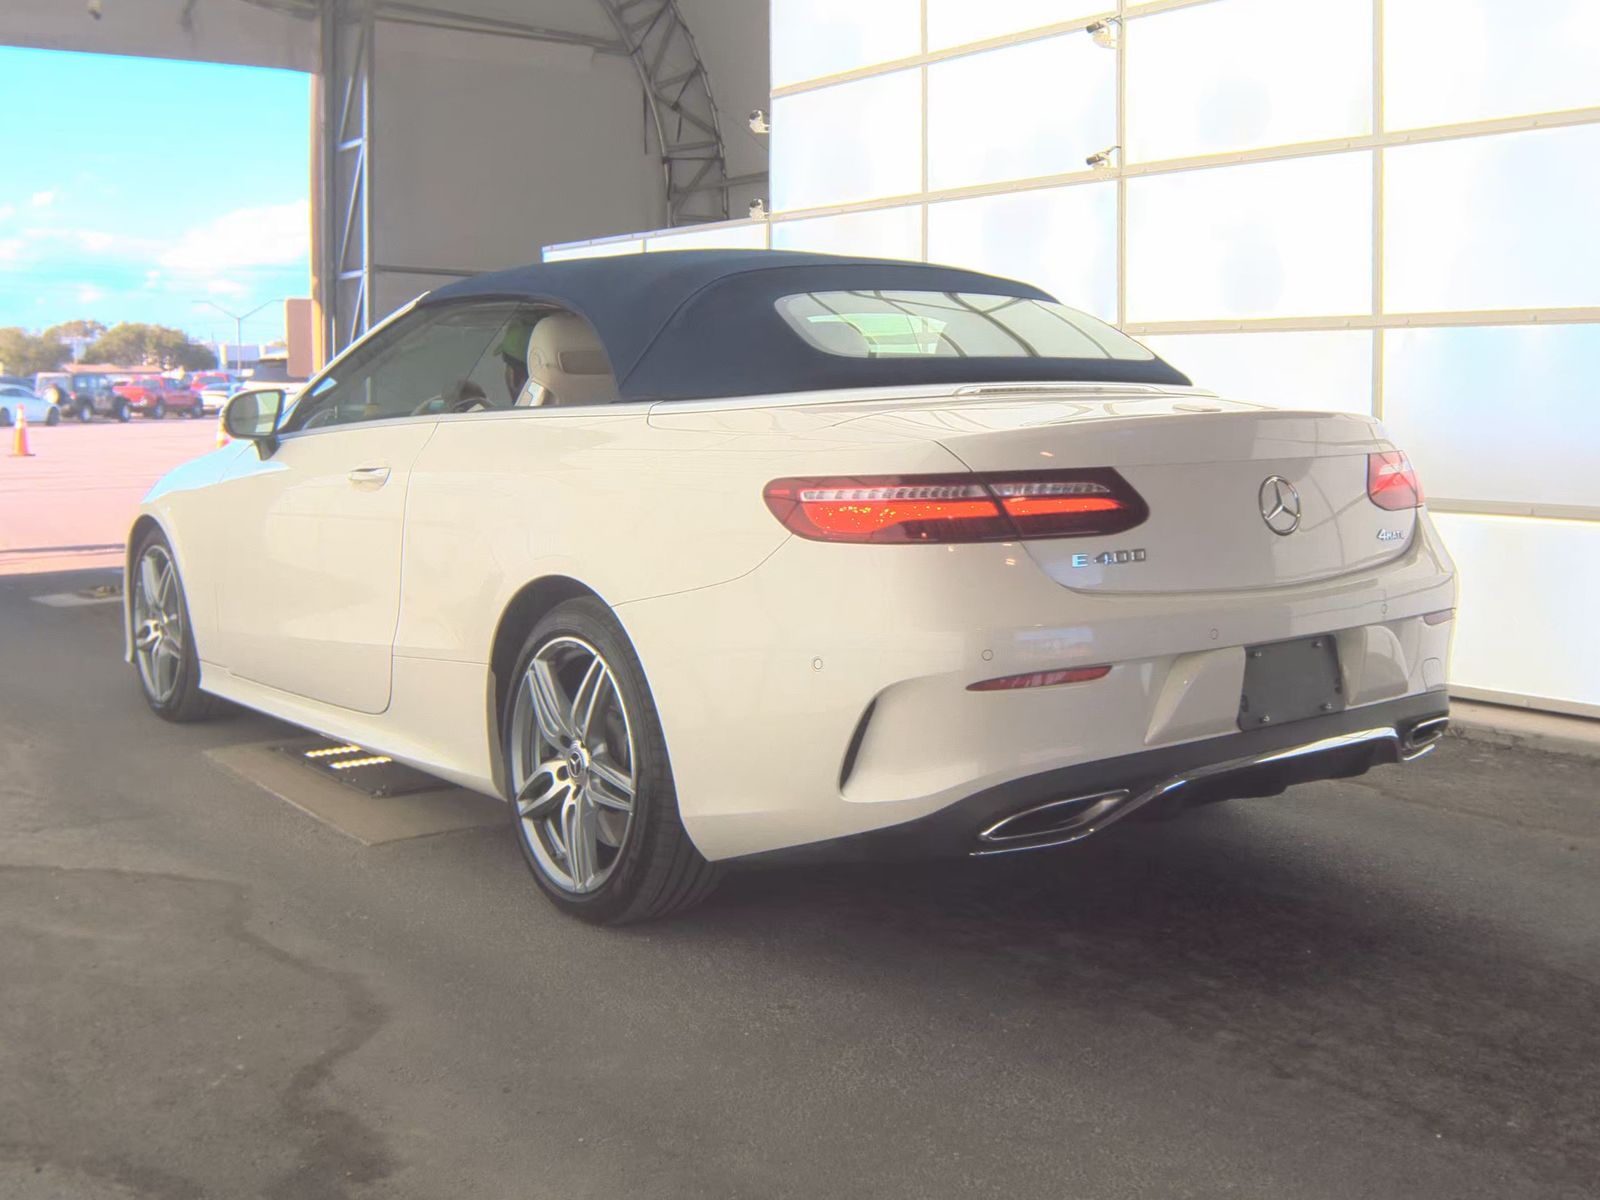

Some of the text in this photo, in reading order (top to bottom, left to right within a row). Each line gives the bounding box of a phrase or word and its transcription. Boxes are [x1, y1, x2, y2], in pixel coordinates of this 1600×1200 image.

[1376, 529, 1405, 540] 4MAT
[1071, 548, 1147, 568] E 400
